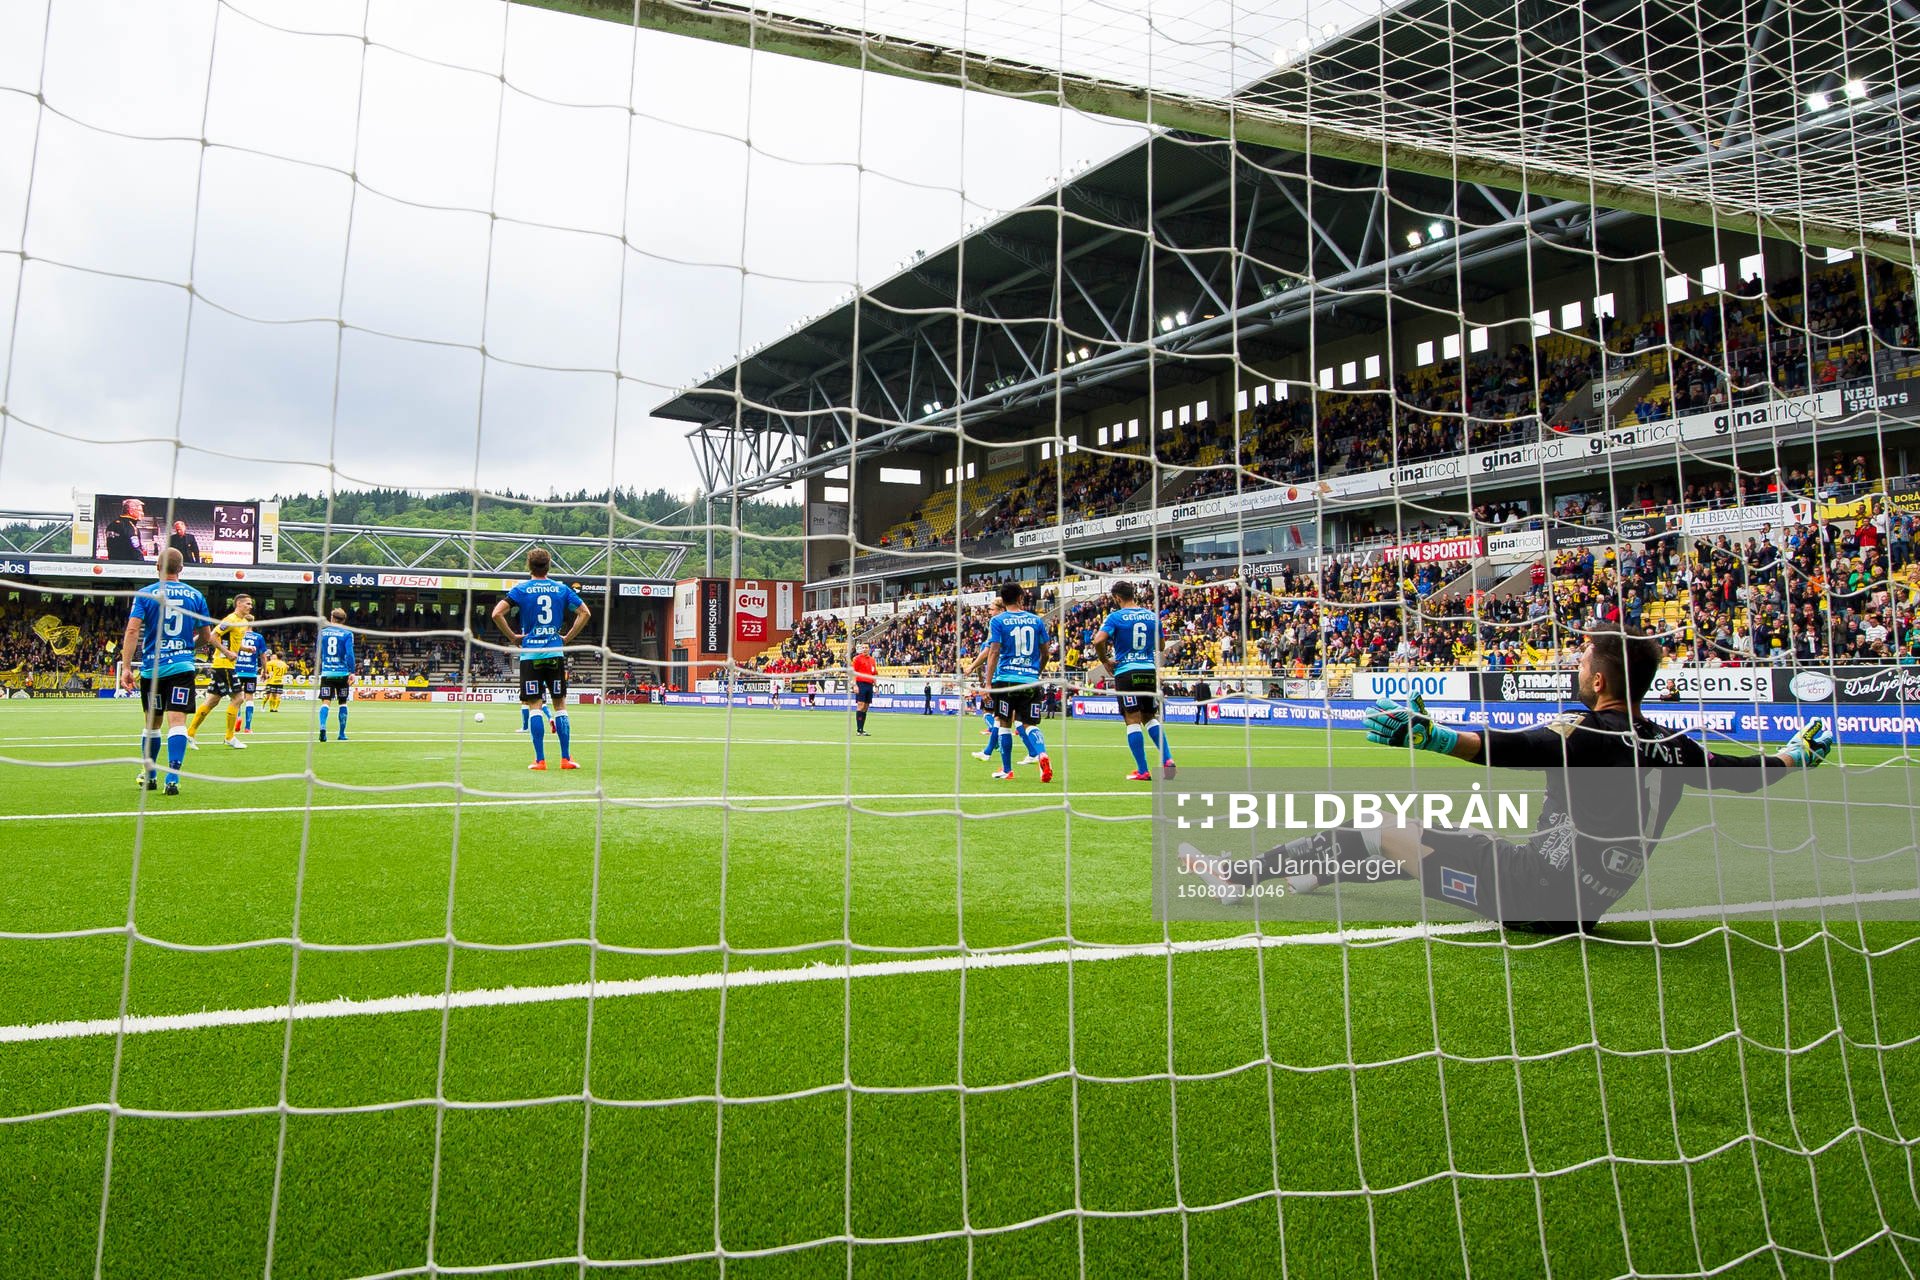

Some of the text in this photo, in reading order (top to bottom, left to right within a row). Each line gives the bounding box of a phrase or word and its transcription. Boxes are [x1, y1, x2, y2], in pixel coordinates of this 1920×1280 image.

[1850, 393, 1909, 412] SPORTS
[220, 512, 228, 523] 2
[240, 514, 249, 524] 0
[1689, 504, 1785, 524] 7H BEVAKNING
[219, 527, 249, 539] 50:44
[349, 573, 375, 586] ellos
[382, 575, 438, 587] PULSEN
[152, 588, 196, 600] GTINGE
[536, 594, 553, 625] 3
[164, 599, 184, 637] 5
[741, 624, 762, 634] 7-23
[1132, 622, 1148, 651] 6
[327, 636, 338, 656] 8
[1010, 625, 1035, 657] 10
[1371, 676, 1448, 698] uponor
[1273, 707, 1288, 718] SEE
[1289, 708, 1307, 719] YOU
[1308, 709, 1320, 720] ON
[1469, 712, 1489, 724] SEE
[1491, 712, 1515, 725] YOU
[1518, 713, 1533, 725] ON
[1741, 716, 1769, 730] SEE
[1773, 716, 1805, 731] YOU
